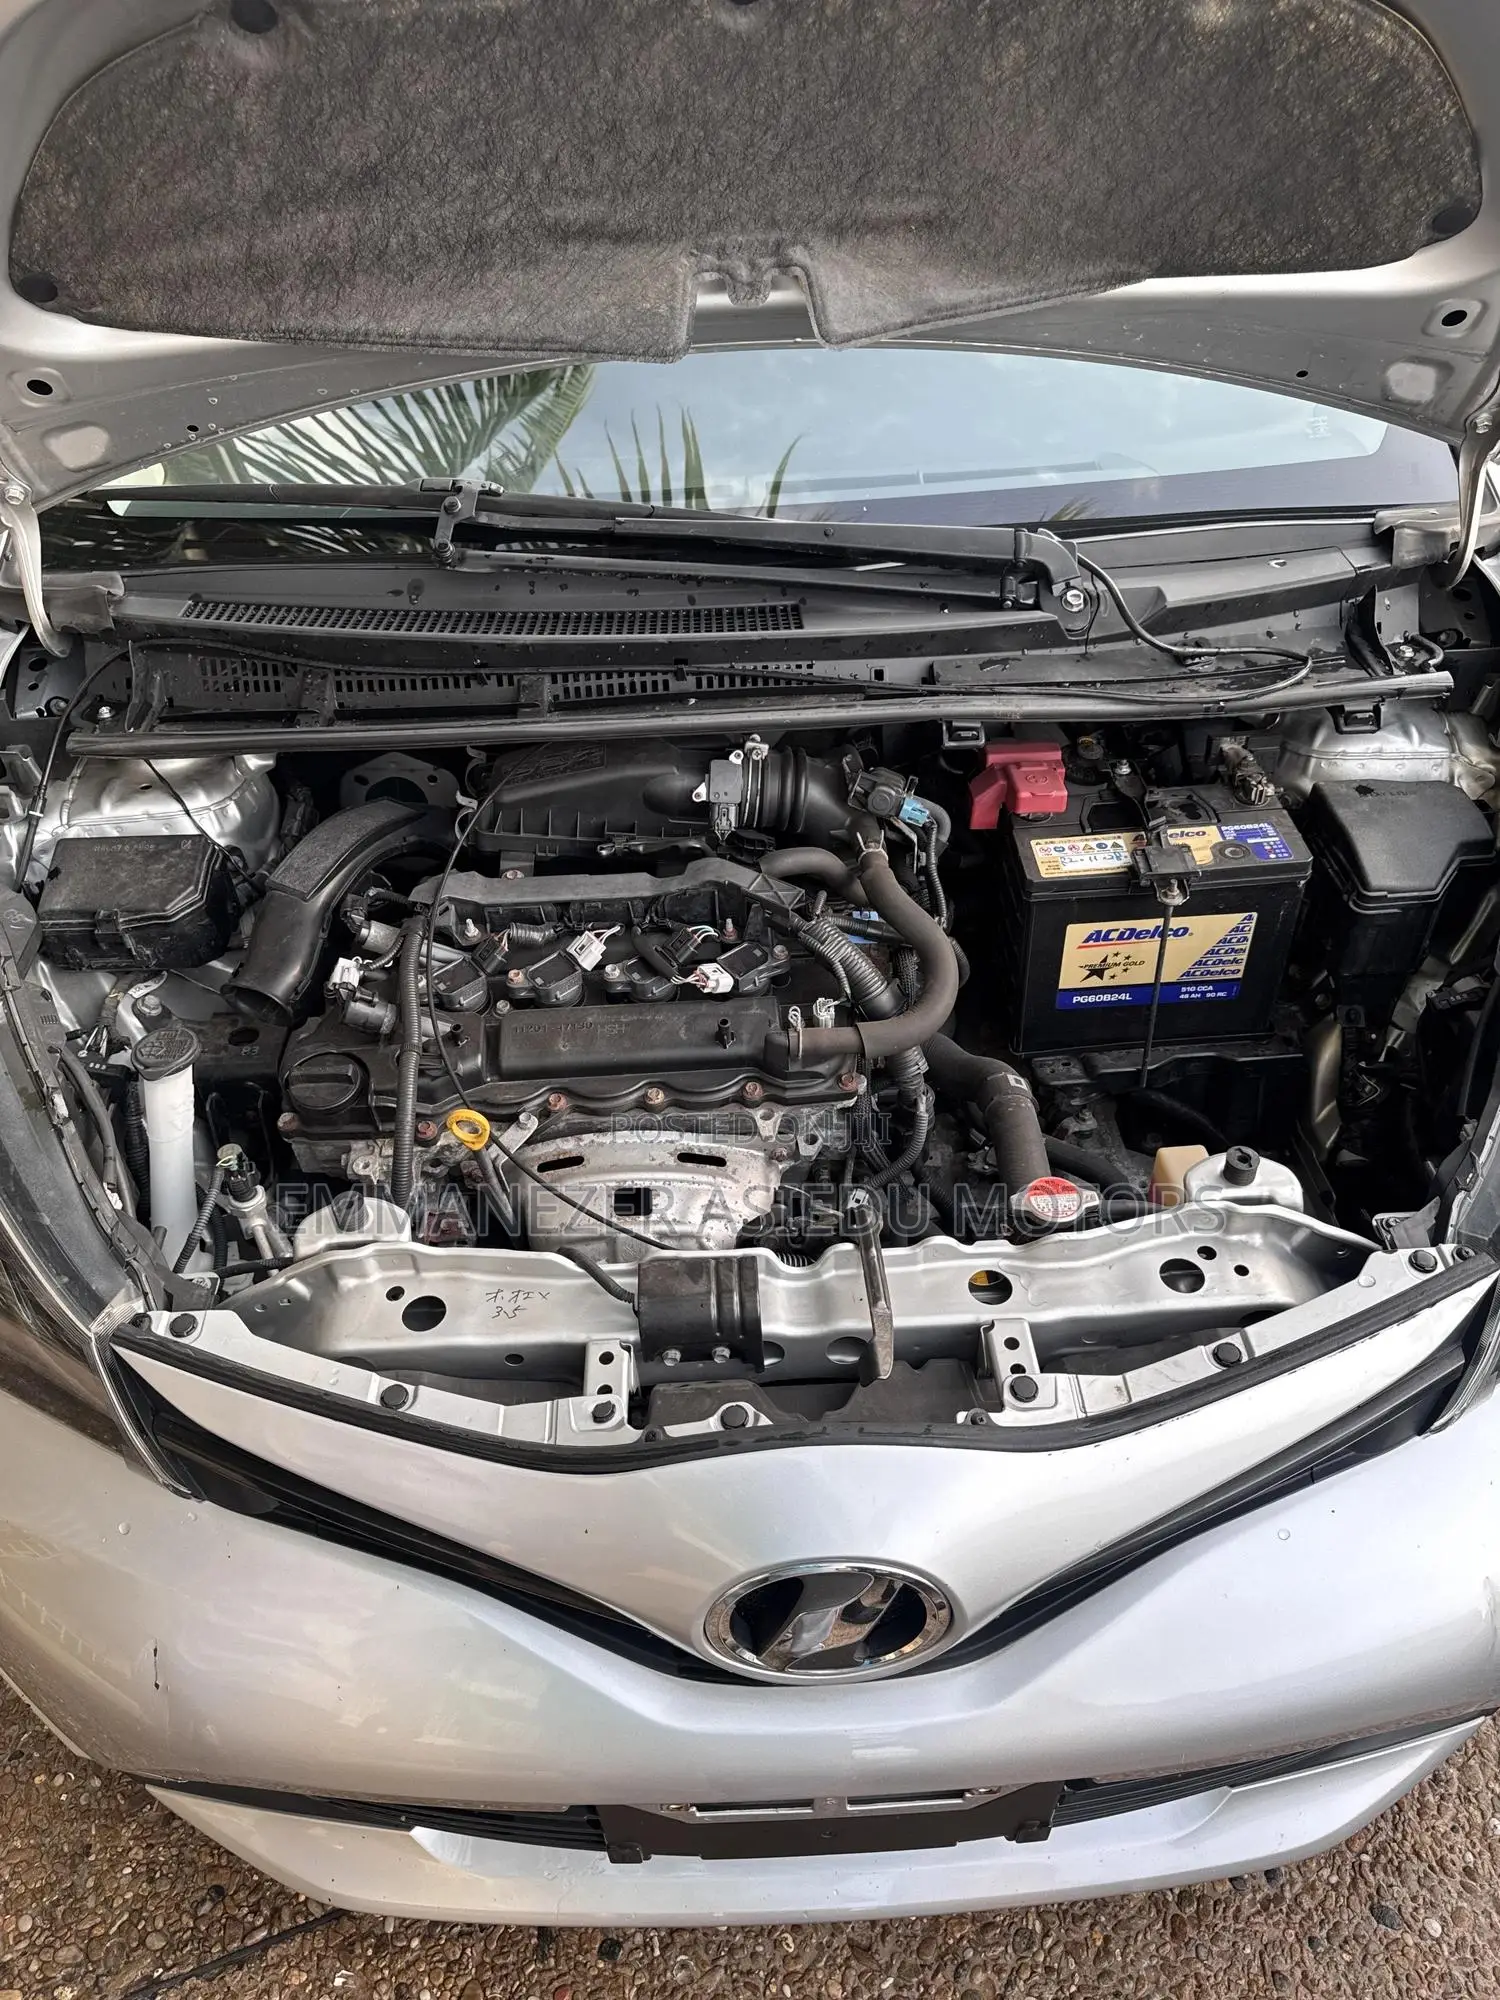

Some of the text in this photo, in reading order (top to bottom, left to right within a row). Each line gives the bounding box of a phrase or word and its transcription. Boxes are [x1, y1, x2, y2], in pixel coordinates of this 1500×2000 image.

[1082, 925, 1190, 943] ACDelco
[1084, 961, 1122, 969] PREMIUM
[1180, 968, 1241, 978] ACDelco
[1072, 992, 1133, 1004] PG60B24L
